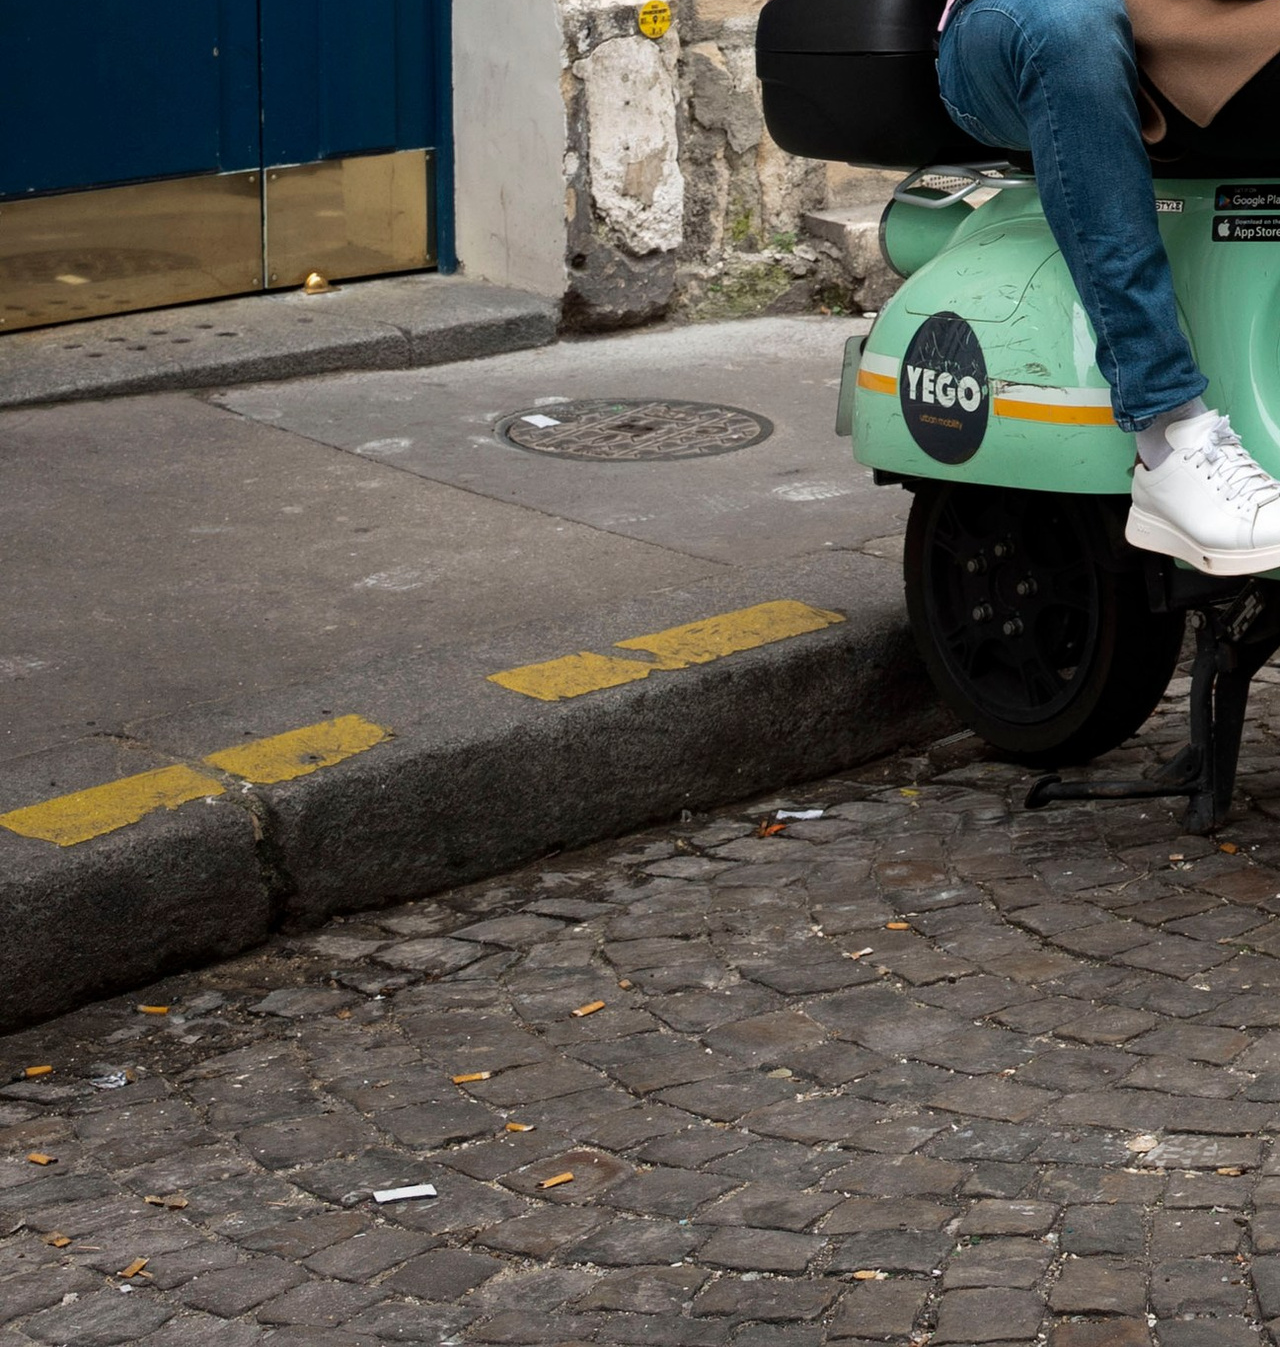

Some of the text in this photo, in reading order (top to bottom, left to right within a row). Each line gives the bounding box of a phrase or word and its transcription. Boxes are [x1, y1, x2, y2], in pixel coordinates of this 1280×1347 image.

[1232, 194, 1266, 208] Google
[1234, 226, 1255, 239] App
[906, 364, 982, 413] YEGO
[919, 414, 963, 432] urban mobility
